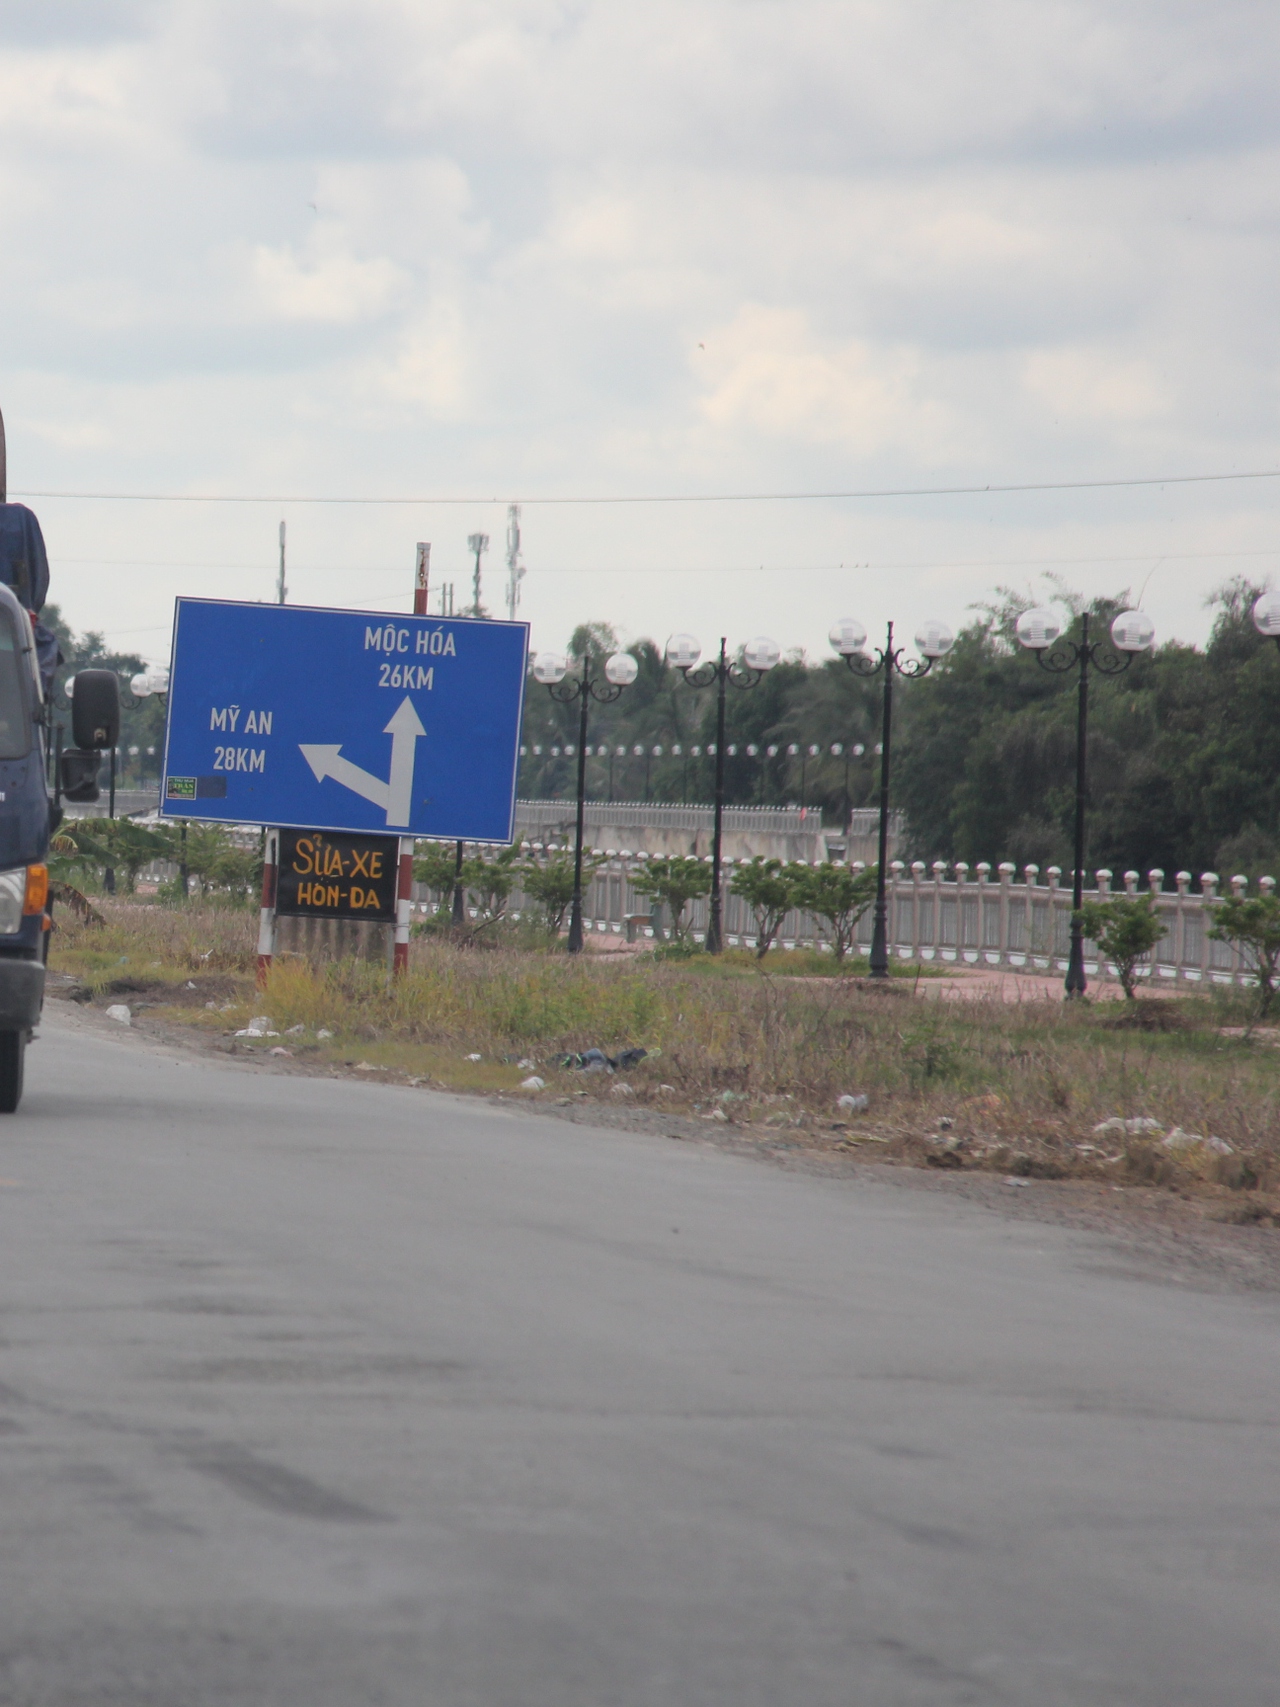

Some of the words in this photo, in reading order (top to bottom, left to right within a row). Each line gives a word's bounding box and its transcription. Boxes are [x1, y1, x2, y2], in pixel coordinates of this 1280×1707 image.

[364, 623, 410, 657] MỘC
[415, 625, 456, 657] HÓA
[378, 663, 434, 691] 26KM
[209, 704, 241, 732] MỸ
[244, 710, 273, 735] AN
[213, 746, 266, 773] 28KM
[297, 882, 381, 909] HON-DA
